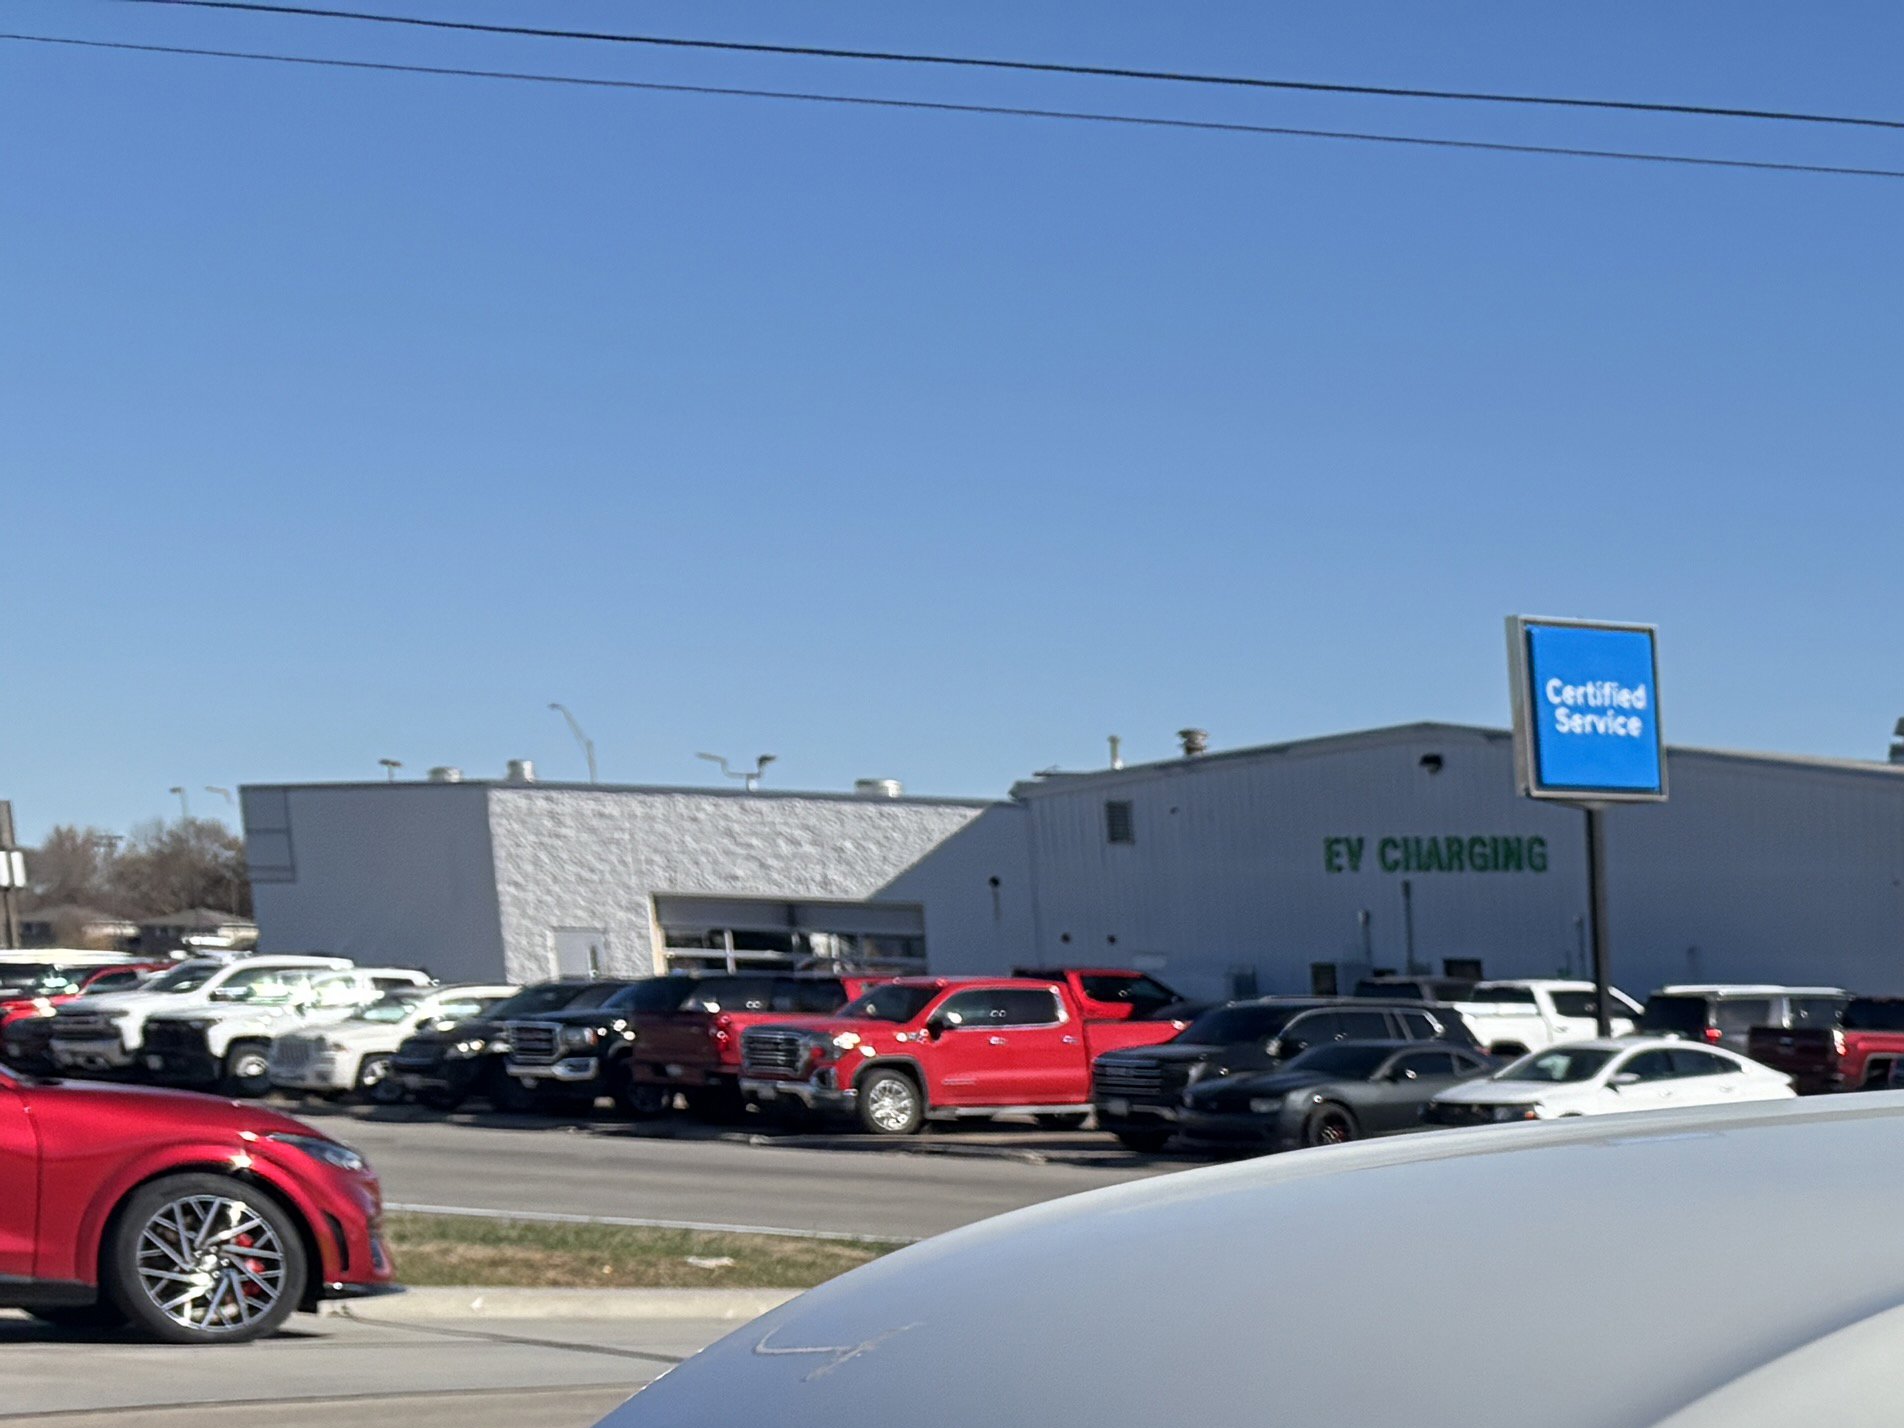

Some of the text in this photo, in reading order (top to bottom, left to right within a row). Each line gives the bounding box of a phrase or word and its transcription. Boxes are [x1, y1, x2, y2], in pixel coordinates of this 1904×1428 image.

[1546, 678, 1648, 710] Certified
[1555, 706, 1643, 738] Service
[1323, 836, 1548, 873] EV CHARGING
